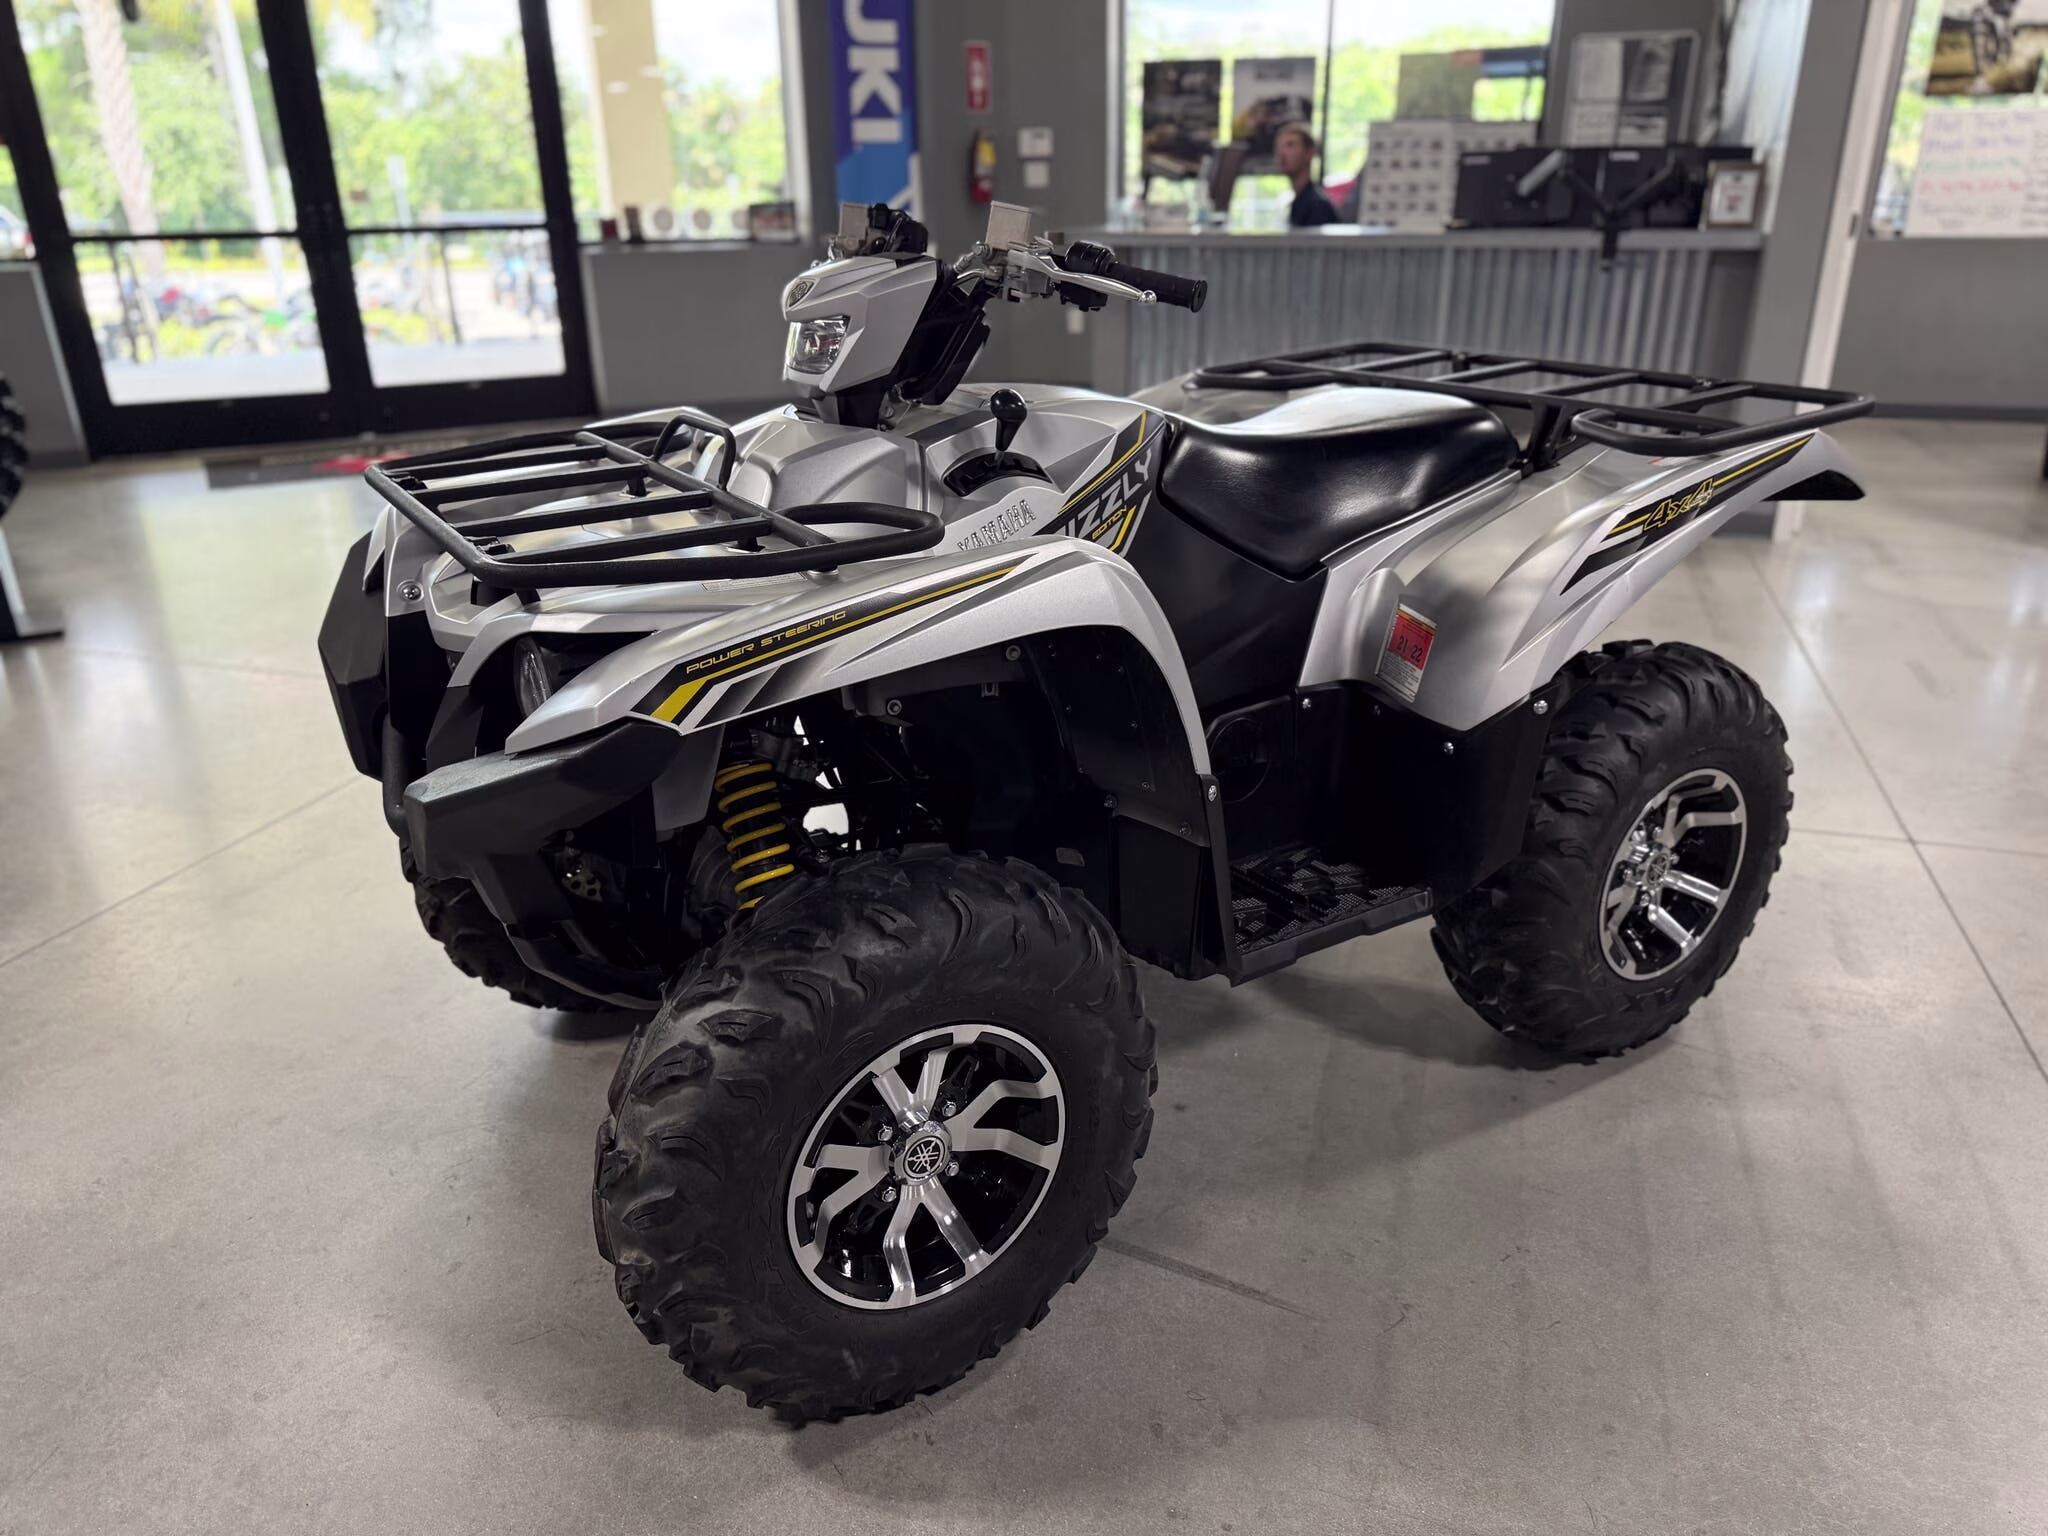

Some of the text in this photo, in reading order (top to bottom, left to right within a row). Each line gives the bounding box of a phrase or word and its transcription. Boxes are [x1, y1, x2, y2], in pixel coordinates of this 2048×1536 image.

[1056, 447, 1152, 539] IZZLY
[1643, 478, 1714, 531] 4x4
[1091, 505, 1128, 540] EDITION
[686, 610, 847, 674] POWER STEERING
